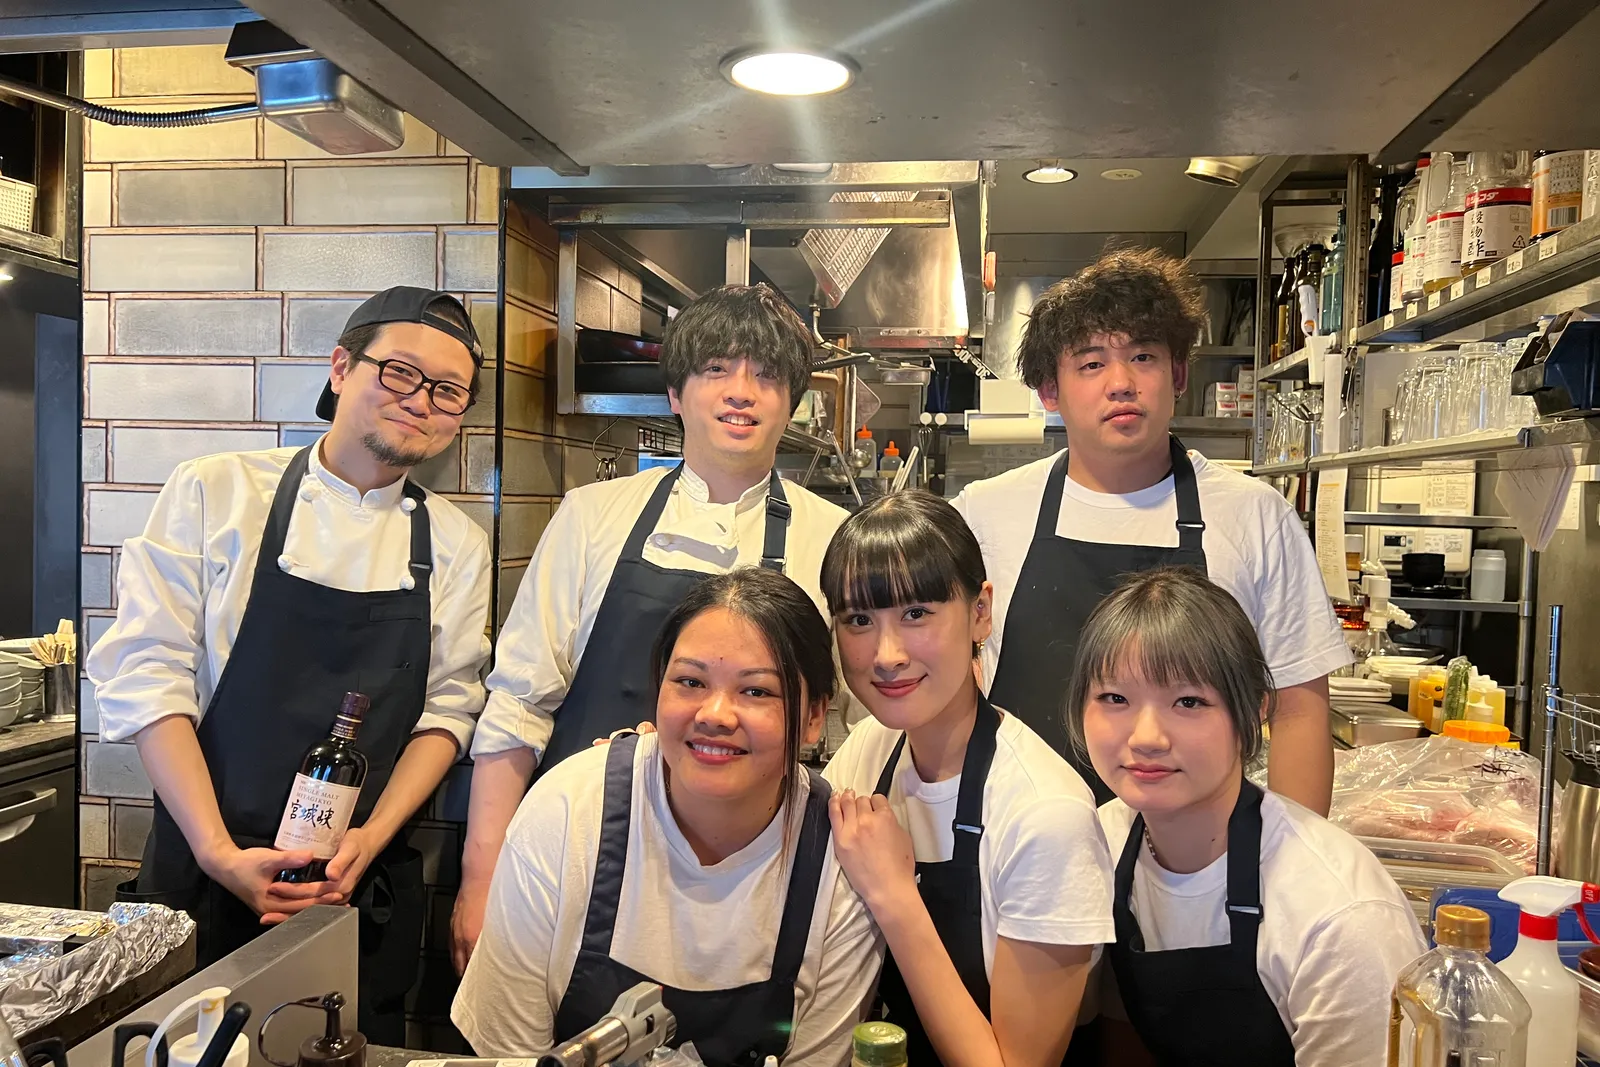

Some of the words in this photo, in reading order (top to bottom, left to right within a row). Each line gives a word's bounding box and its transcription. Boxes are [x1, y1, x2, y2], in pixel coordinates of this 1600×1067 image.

[299, 785, 320, 796] SINGLE
[321, 791, 340, 801] MALT
[290, 799, 335, 830] 宮城峡
[1585, 890, 1594, 902] OFF
